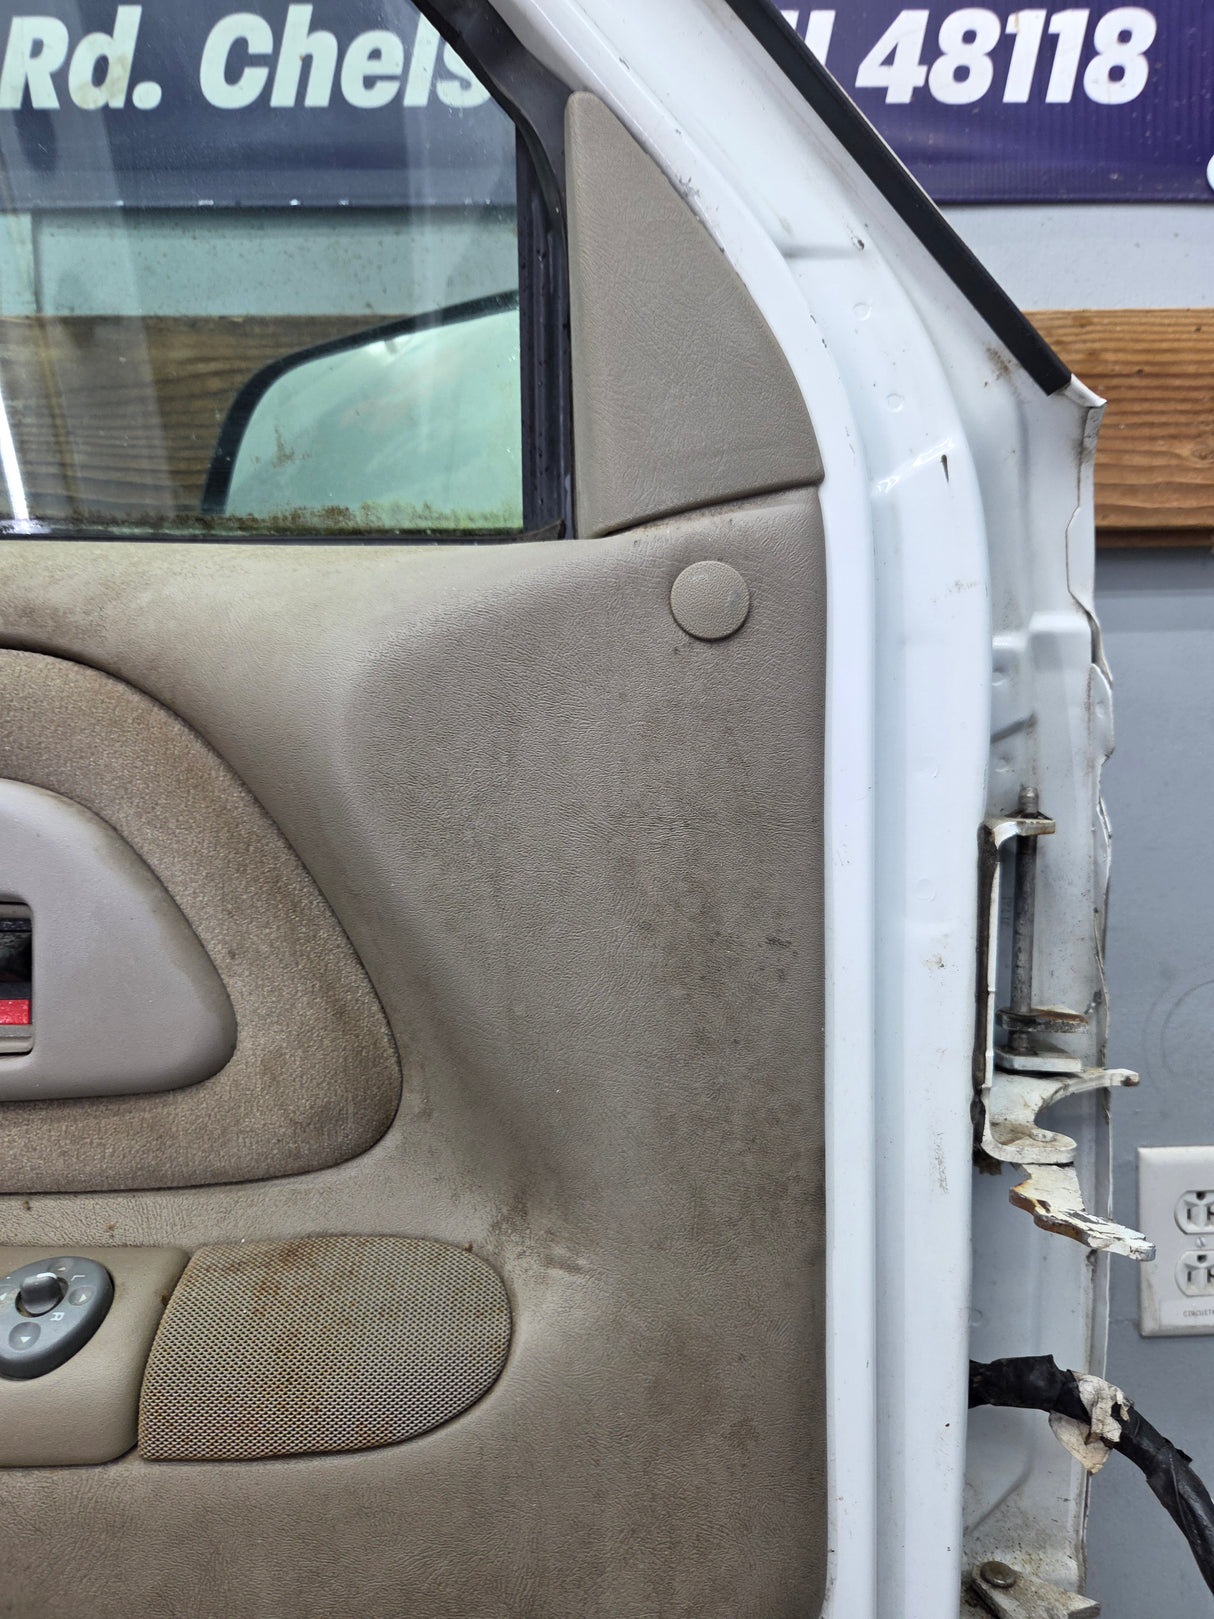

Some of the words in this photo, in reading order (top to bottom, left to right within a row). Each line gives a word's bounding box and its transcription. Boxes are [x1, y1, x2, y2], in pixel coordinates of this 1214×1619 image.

[0, 4, 162, 110] Rd.
[200, 4, 491, 108] Chels
[855, 7, 1157, 105] 48118
[49, 1311, 65, 1321] R
